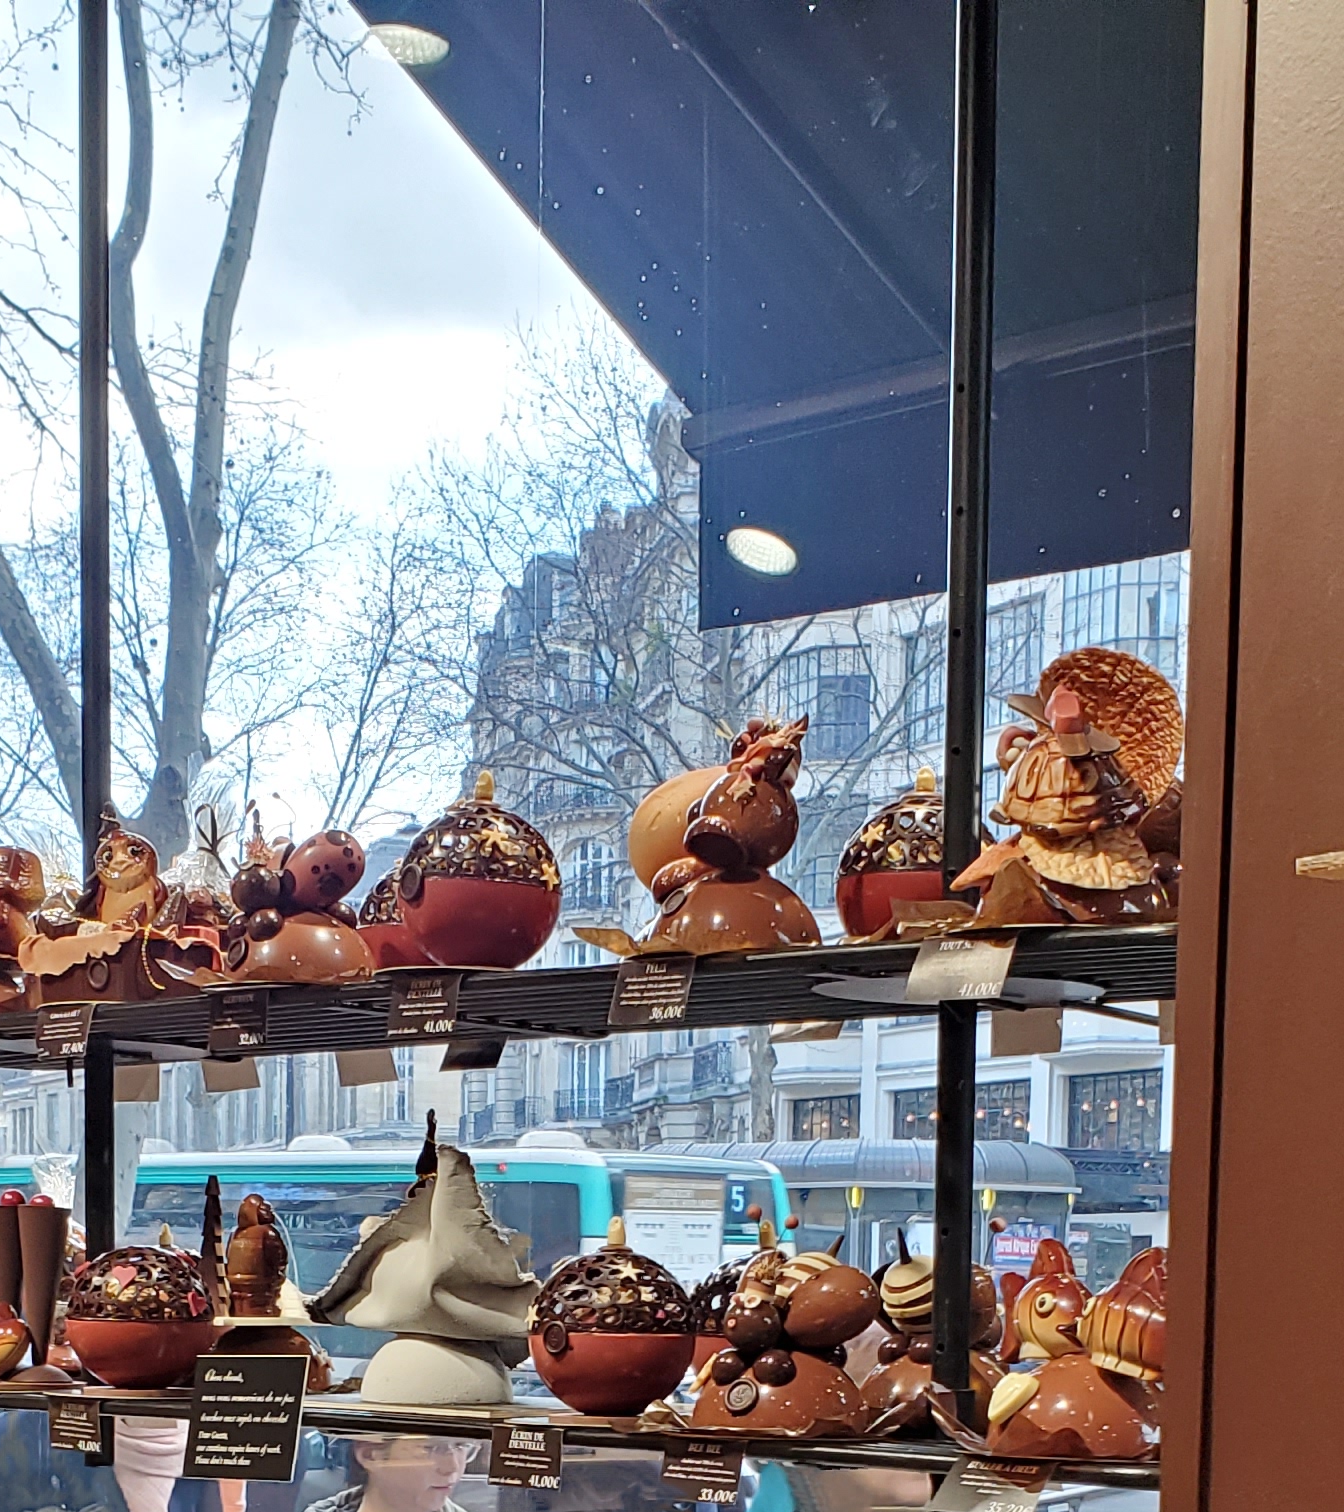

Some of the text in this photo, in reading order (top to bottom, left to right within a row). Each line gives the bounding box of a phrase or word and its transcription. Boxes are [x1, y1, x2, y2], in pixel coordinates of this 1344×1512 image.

[958, 982, 1001, 997] 41,00€
[423, 1019, 455, 1034] 41,00€
[731, 1185, 745, 1212] 5
[528, 1474, 561, 1489] 41,00€
